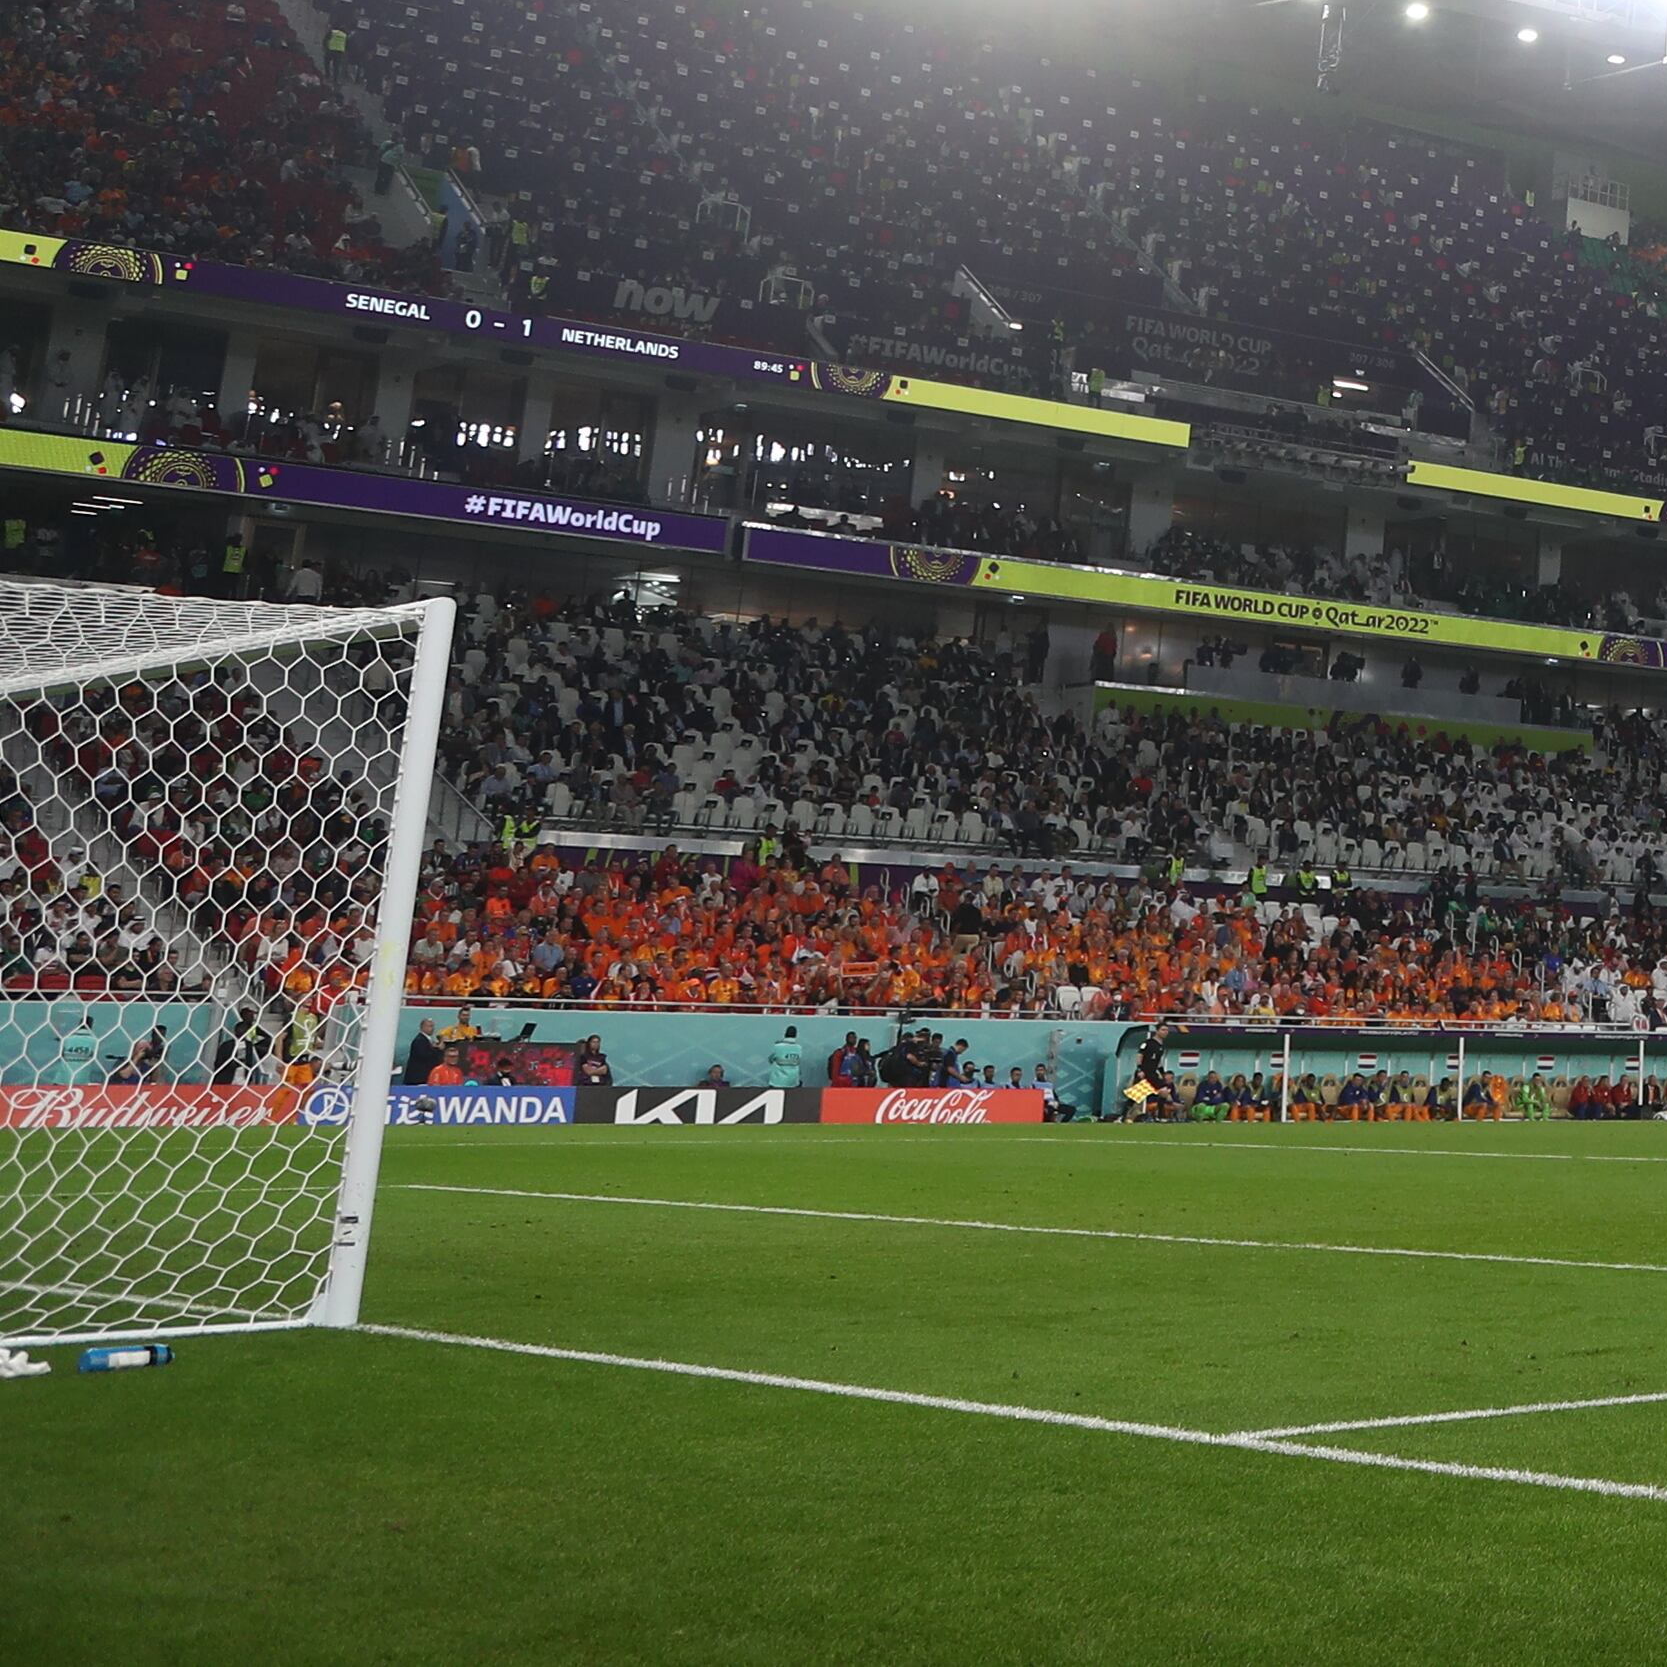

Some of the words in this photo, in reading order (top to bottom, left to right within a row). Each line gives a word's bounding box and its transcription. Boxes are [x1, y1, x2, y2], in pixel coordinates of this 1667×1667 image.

[613, 278, 721, 322] now
[345, 293, 430, 321] SENEGAL
[464, 310, 482, 329] 0
[521, 319, 532, 337] 1
[561, 327, 679, 359] NETHERLANDS
[753, 360, 784, 374] 89:45
[1125, 315, 1166, 337] FIFA
[1168, 321, 1235, 350] WORLD
[1237, 335, 1272, 355] CUP
[464, 494, 661, 541] #FIFAWorldCup
[1174, 589, 1212, 608] FIFA
[1213, 594, 1274, 616] WORLD
[1277, 602, 1310, 620] CUP
[438, 1096, 567, 1124] WANDA
